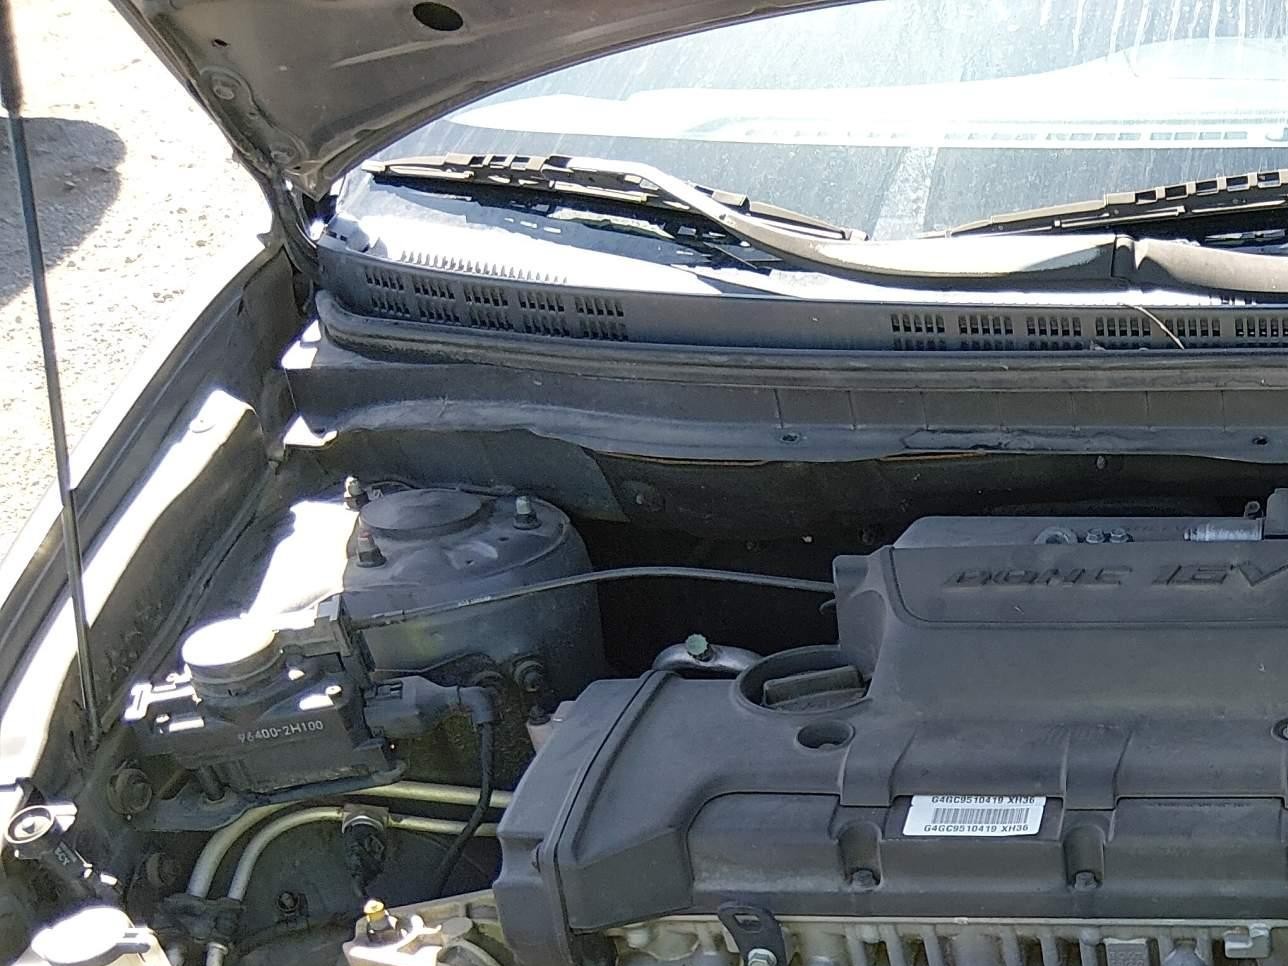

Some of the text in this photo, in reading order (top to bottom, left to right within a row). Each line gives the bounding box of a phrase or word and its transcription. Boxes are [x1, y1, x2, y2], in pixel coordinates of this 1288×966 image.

[237, 719, 324, 744] 96400-2H100
[923, 824, 1029, 833] G4GC9510419 XH36
